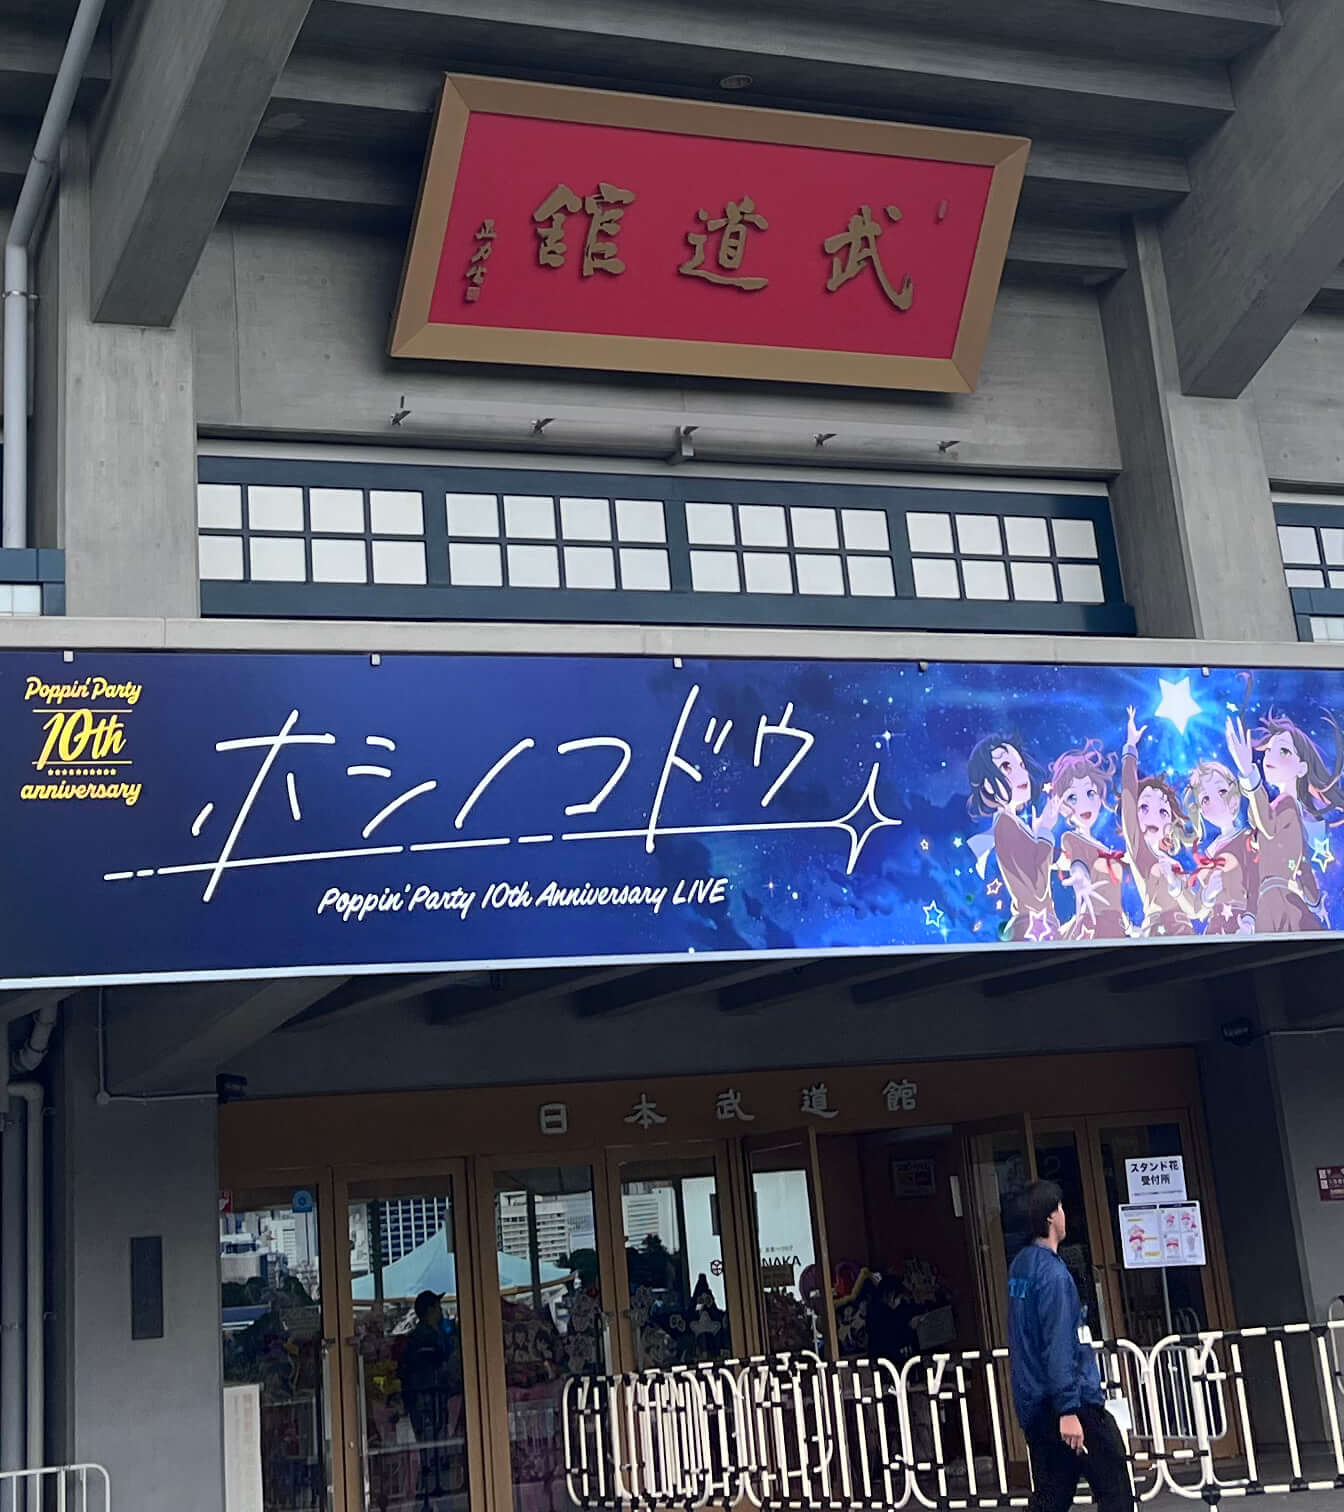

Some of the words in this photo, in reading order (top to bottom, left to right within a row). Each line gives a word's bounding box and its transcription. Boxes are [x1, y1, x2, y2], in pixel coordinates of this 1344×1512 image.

[36, 708, 127, 770] 10th
[20, 780, 143, 806] anniversary
[191, 683, 816, 902] ホシノコドウ
[480, 881, 533, 909] 10th
[535, 879, 668, 914] Anniversary
[672, 878, 729, 905] LIVE
[540, 1079, 919, 1135] 日本武道館
[1130, 1160, 1179, 1173] スタンド花
[1141, 1174, 1171, 1186] 受付所
